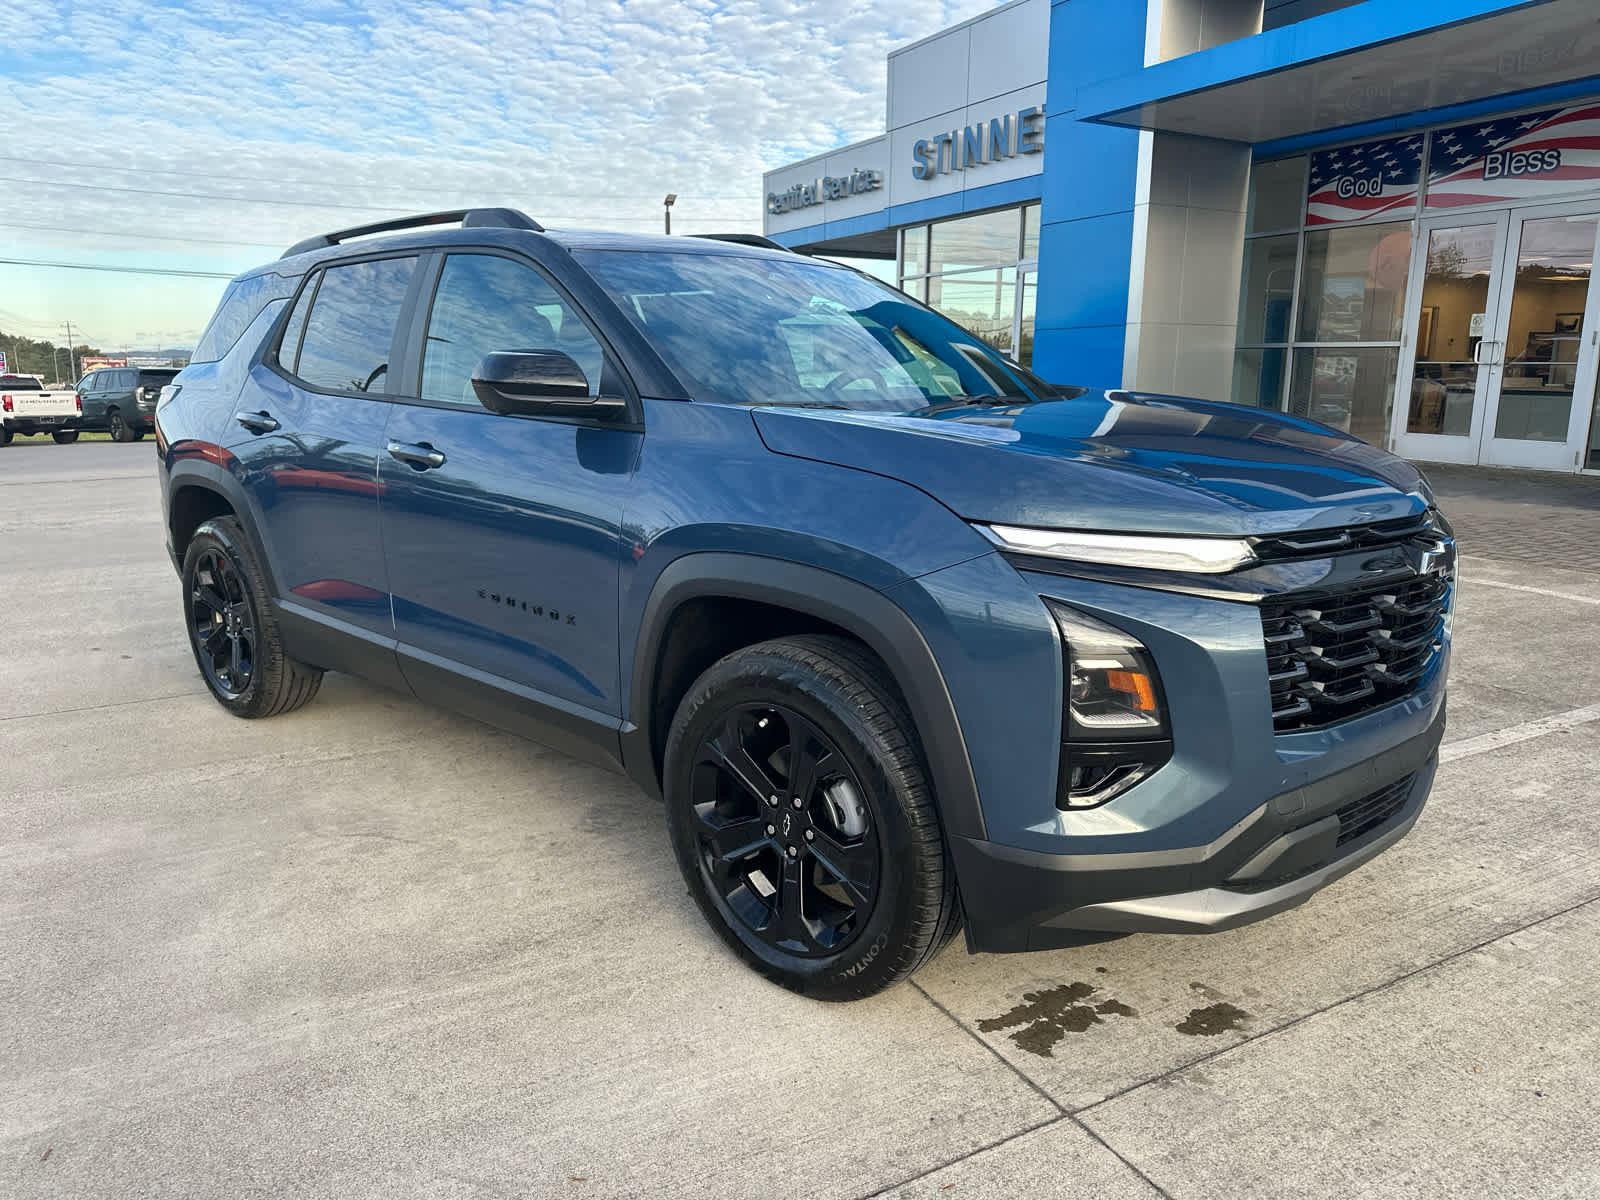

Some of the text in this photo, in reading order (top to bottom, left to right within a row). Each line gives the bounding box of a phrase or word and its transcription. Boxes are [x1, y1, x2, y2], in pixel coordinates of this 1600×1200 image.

[912, 104, 1046, 180] STINNE
[767, 168, 882, 214] Certified Service
[1337, 150, 1561, 199] God Bless
